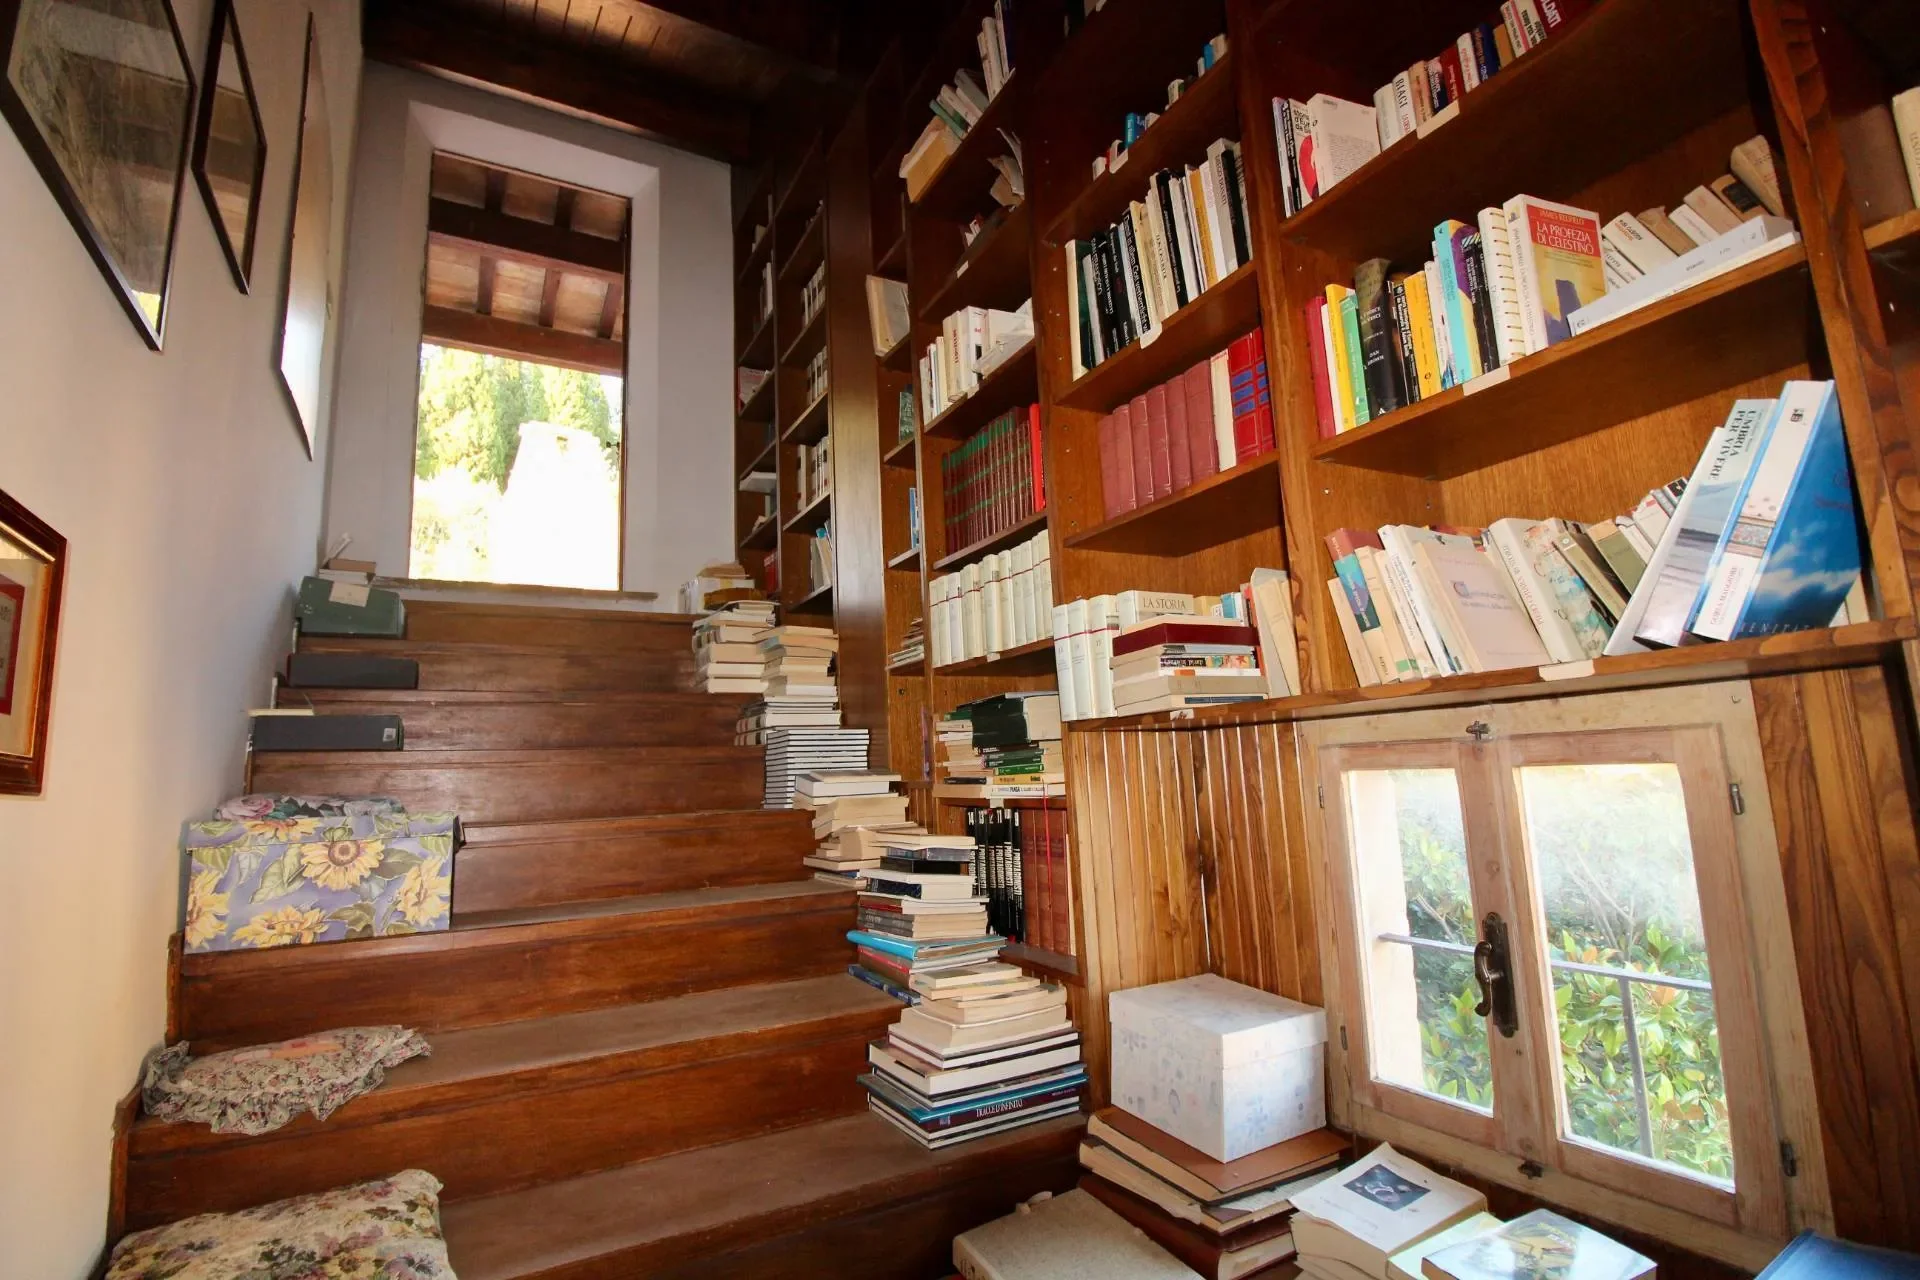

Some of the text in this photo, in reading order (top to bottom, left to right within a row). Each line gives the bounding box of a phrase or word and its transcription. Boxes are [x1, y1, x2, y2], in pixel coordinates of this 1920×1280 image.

[1541, 0, 1561, 28] LDATI
[1536, 221, 1592, 244] LA PROFEZIA
[1536, 233, 1594, 255] DI CELESTINO
[1730, 410, 1757, 456] UMBRIA
[1708, 410, 1746, 480] PER VIVERE
[1143, 597, 1186, 610] LA STORIA
[968, 811, 975, 826] 14
[978, 810, 985, 825] 13
[997, 810, 1003, 824] 11
[1005, 845, 1014, 887] PROTAGONISTI
[1013, 851, 1023, 896] PROTAGONISTI
